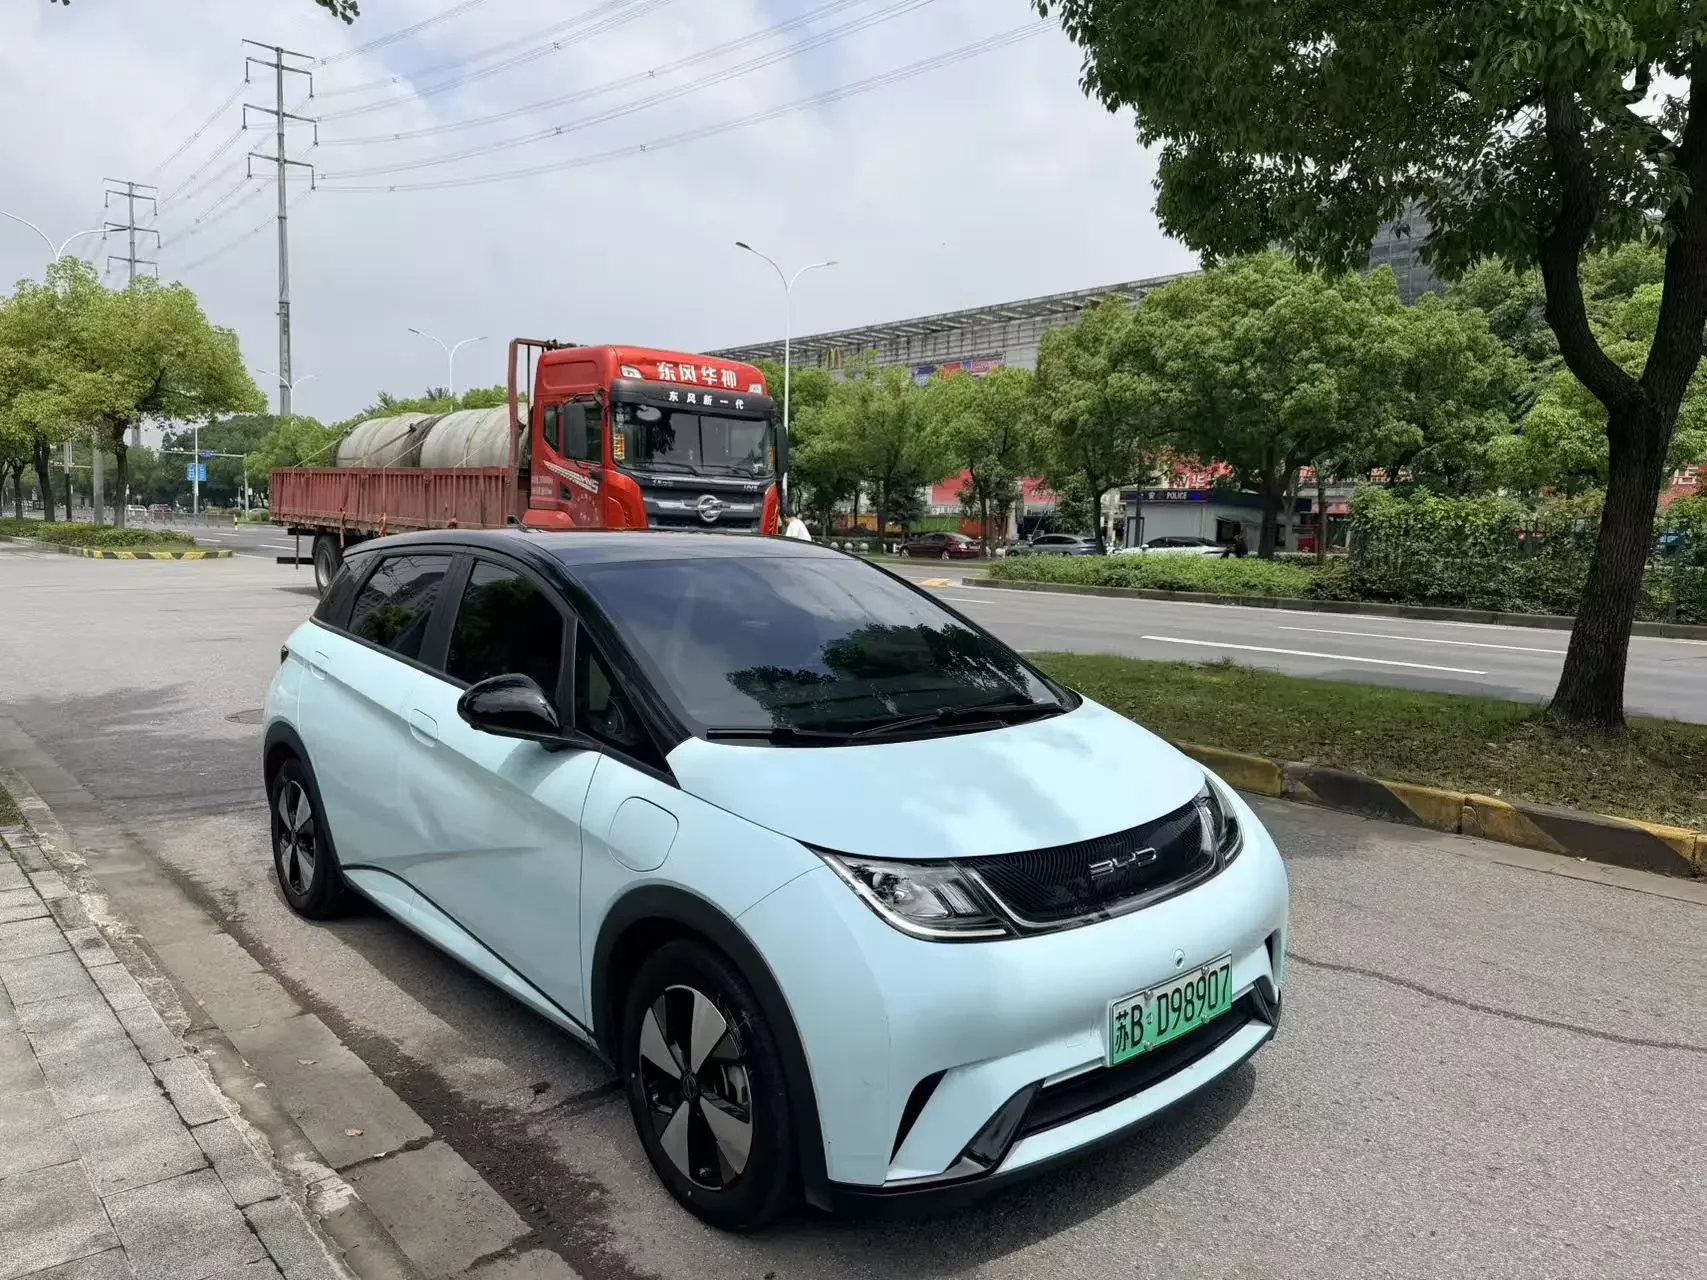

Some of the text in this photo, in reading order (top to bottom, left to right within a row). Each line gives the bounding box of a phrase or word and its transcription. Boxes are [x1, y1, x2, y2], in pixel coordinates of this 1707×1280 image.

[656, 361, 737, 389] 东风华神
[668, 391, 744, 410] 东风新一代
[1166, 491, 1188, 500] POLICE
[1088, 847, 1157, 880] BYD
